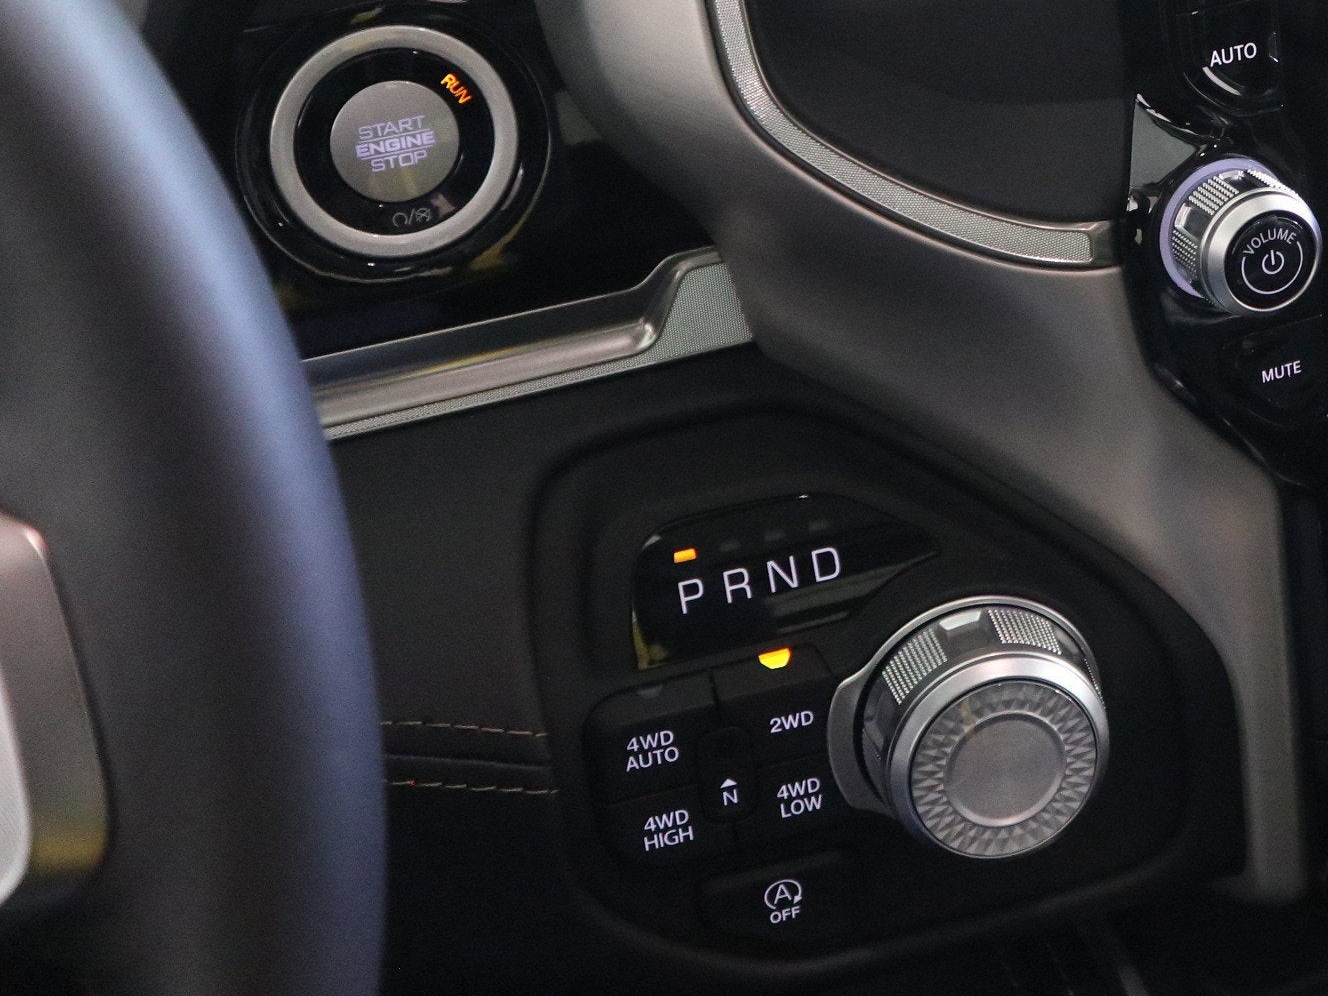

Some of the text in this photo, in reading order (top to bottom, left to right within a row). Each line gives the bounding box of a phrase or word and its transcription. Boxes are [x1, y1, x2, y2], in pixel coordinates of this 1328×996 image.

[1210, 41, 1257, 67] AUTO
[441, 73, 472, 105] RUN
[358, 115, 426, 142] START
[355, 130, 435, 158] ENGINE
[371, 149, 428, 173] STOP
[1242, 227, 1297, 255] VOLUME
[1261, 360, 1301, 383] MUTE
[769, 710, 814, 734] 2WD
[626, 729, 674, 753] 4WD
[625, 745, 679, 773] AUTO
[721, 788, 739, 807] N
[776, 777, 821, 801] 4WD
[779, 793, 823, 819] LOW
[643, 809, 690, 834] 4WD
[643, 826, 695, 853] HIGH
[769, 905, 801, 926] OFF
